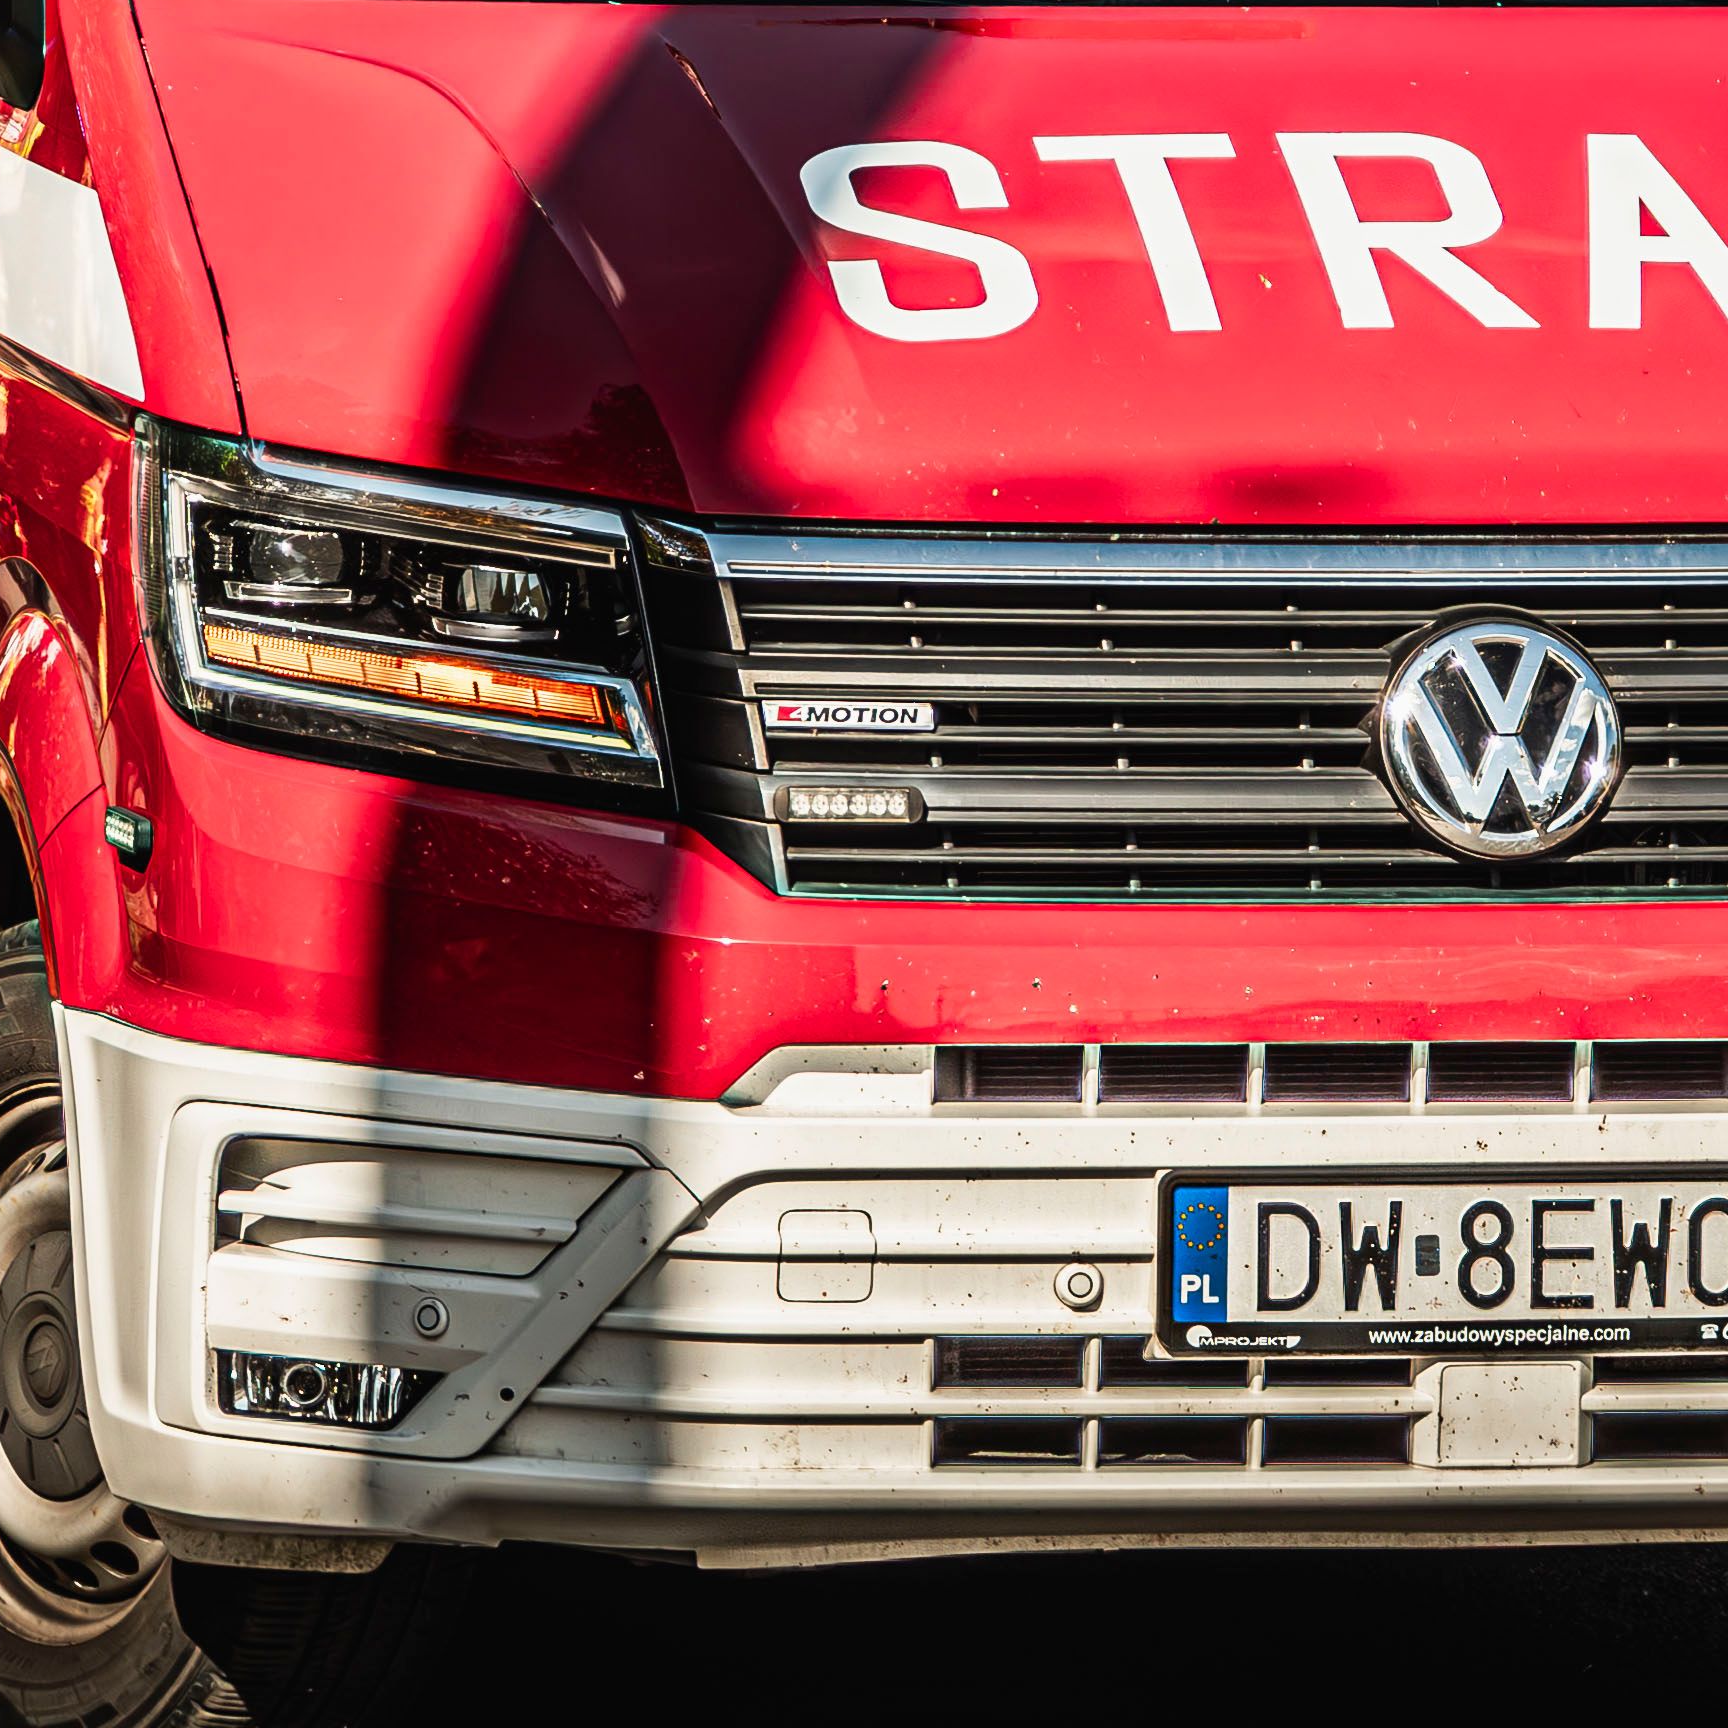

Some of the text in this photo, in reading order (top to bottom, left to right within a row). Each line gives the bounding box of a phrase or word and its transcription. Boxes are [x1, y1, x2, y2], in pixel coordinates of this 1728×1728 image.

[1256, 1199, 1402, 1312] DW
[1180, 1274, 1220, 1305] PL
[1368, 1322, 1632, 1346] www.zabudowyspecjalne.com
